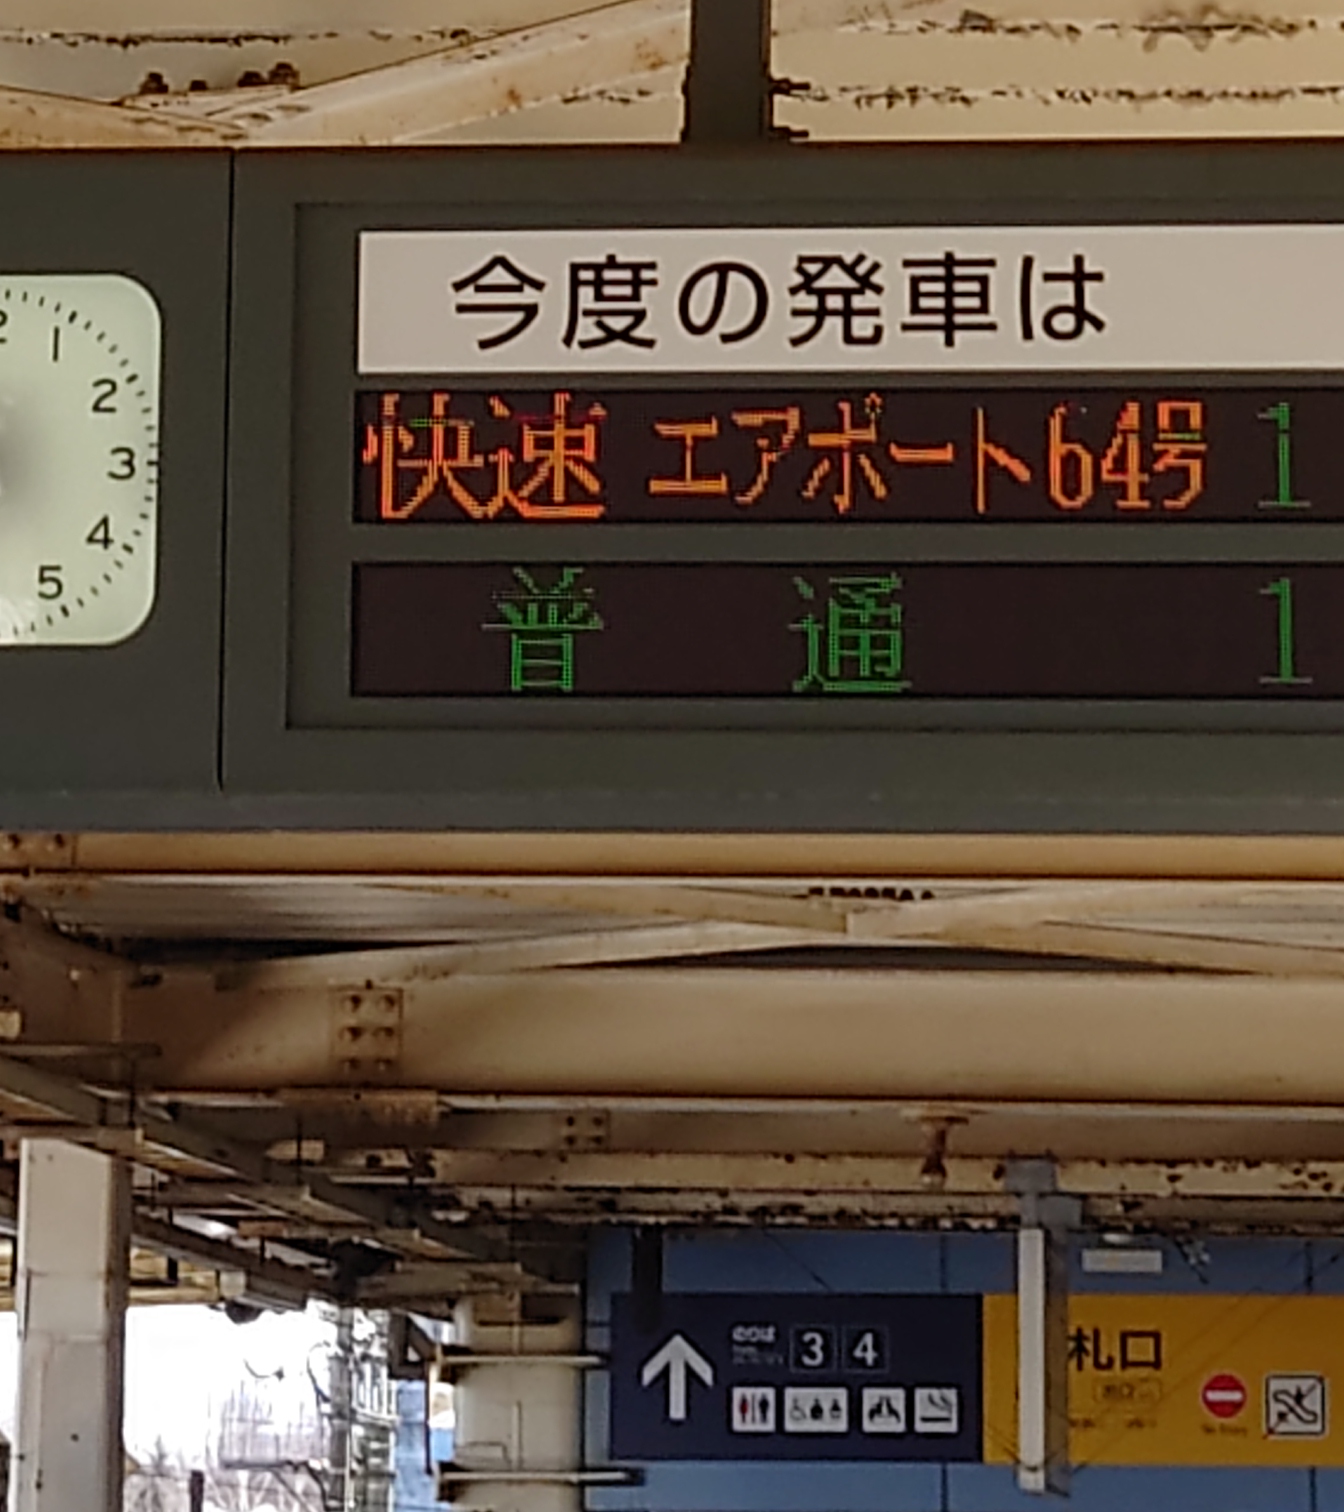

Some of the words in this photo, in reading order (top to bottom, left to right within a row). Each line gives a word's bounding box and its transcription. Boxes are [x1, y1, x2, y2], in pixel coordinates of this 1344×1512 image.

[451, 251, 1108, 351] 今度の発車は
[52, 326, 62, 363] 1
[91, 378, 119, 414] 2
[107, 446, 137, 481] 3
[362, 392, 609, 520] 快速
[648, 391, 1208, 515] エアポート64号
[86, 514, 115, 551] 4
[37, 565, 64, 600] 5
[481, 566, 912, 693] 普通
[801, 1332, 825, 1367] 3
[851, 1332, 879, 1367] 4
